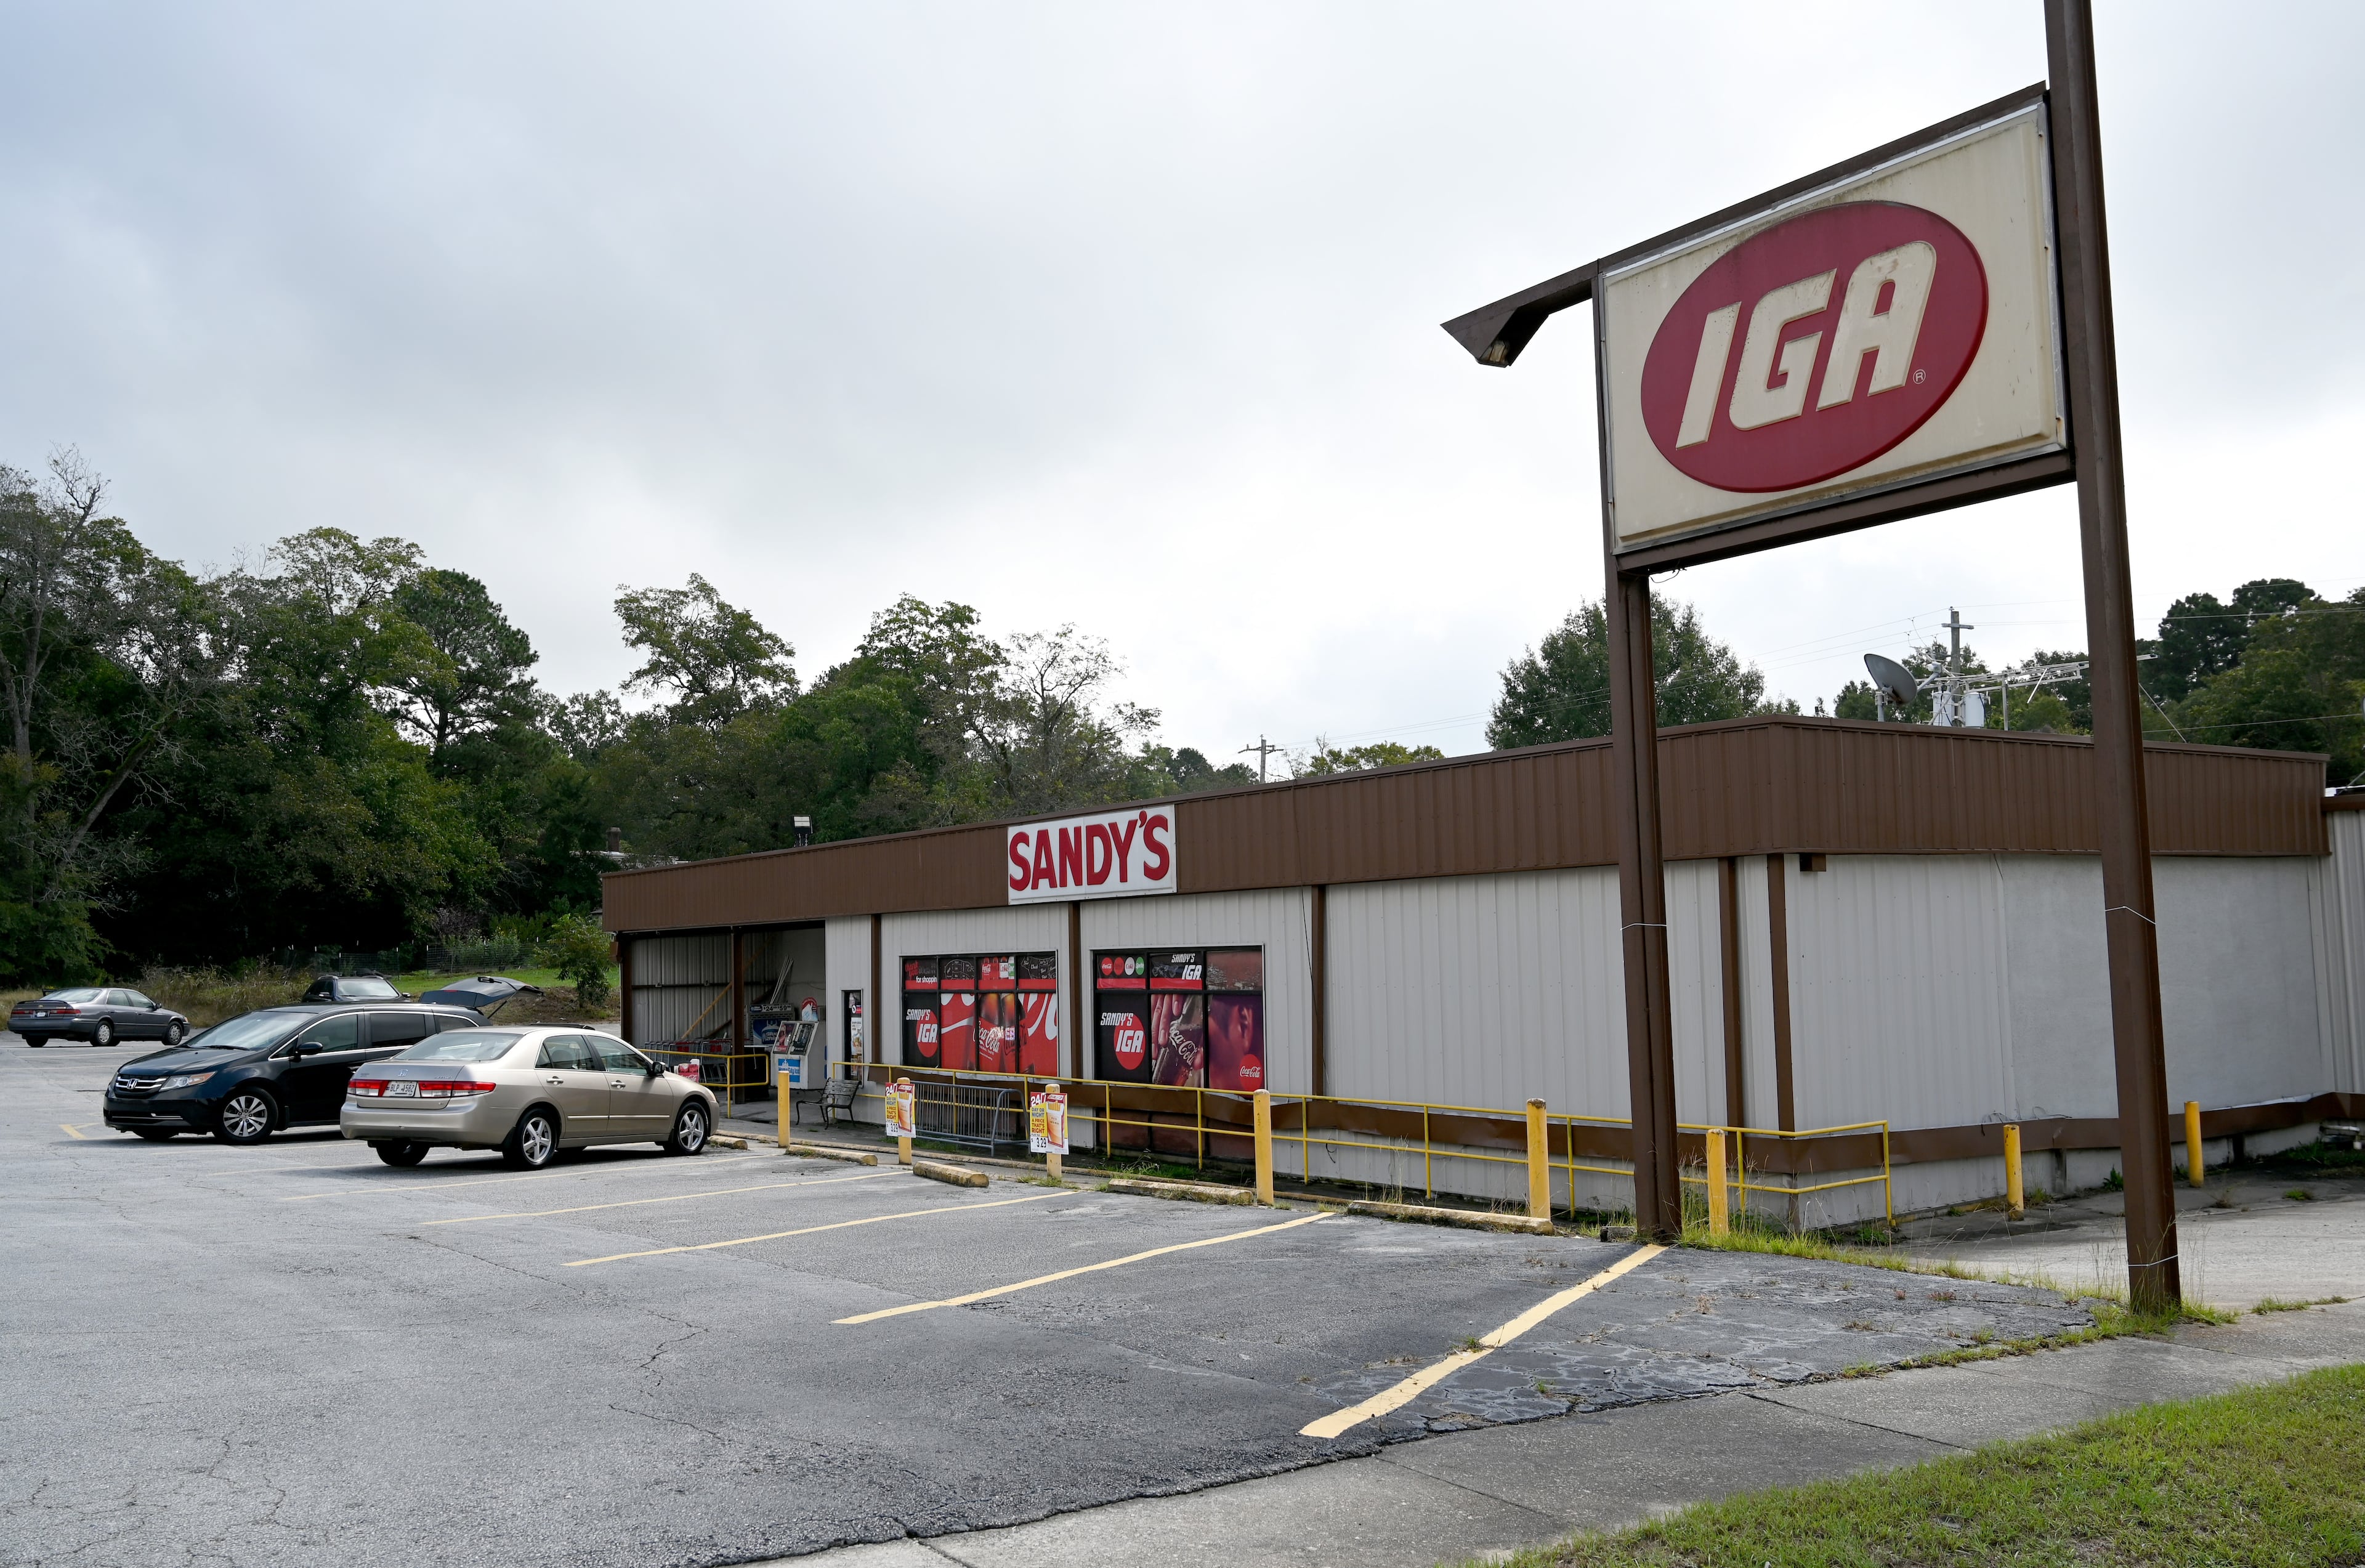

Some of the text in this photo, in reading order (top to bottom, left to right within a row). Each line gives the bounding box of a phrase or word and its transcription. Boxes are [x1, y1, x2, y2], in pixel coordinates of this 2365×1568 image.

[1676, 241, 1937, 450] IGA
[1009, 810, 1170, 892] SANDY'S
[1171, 953, 1195, 963] SANDY'S
[1182, 965, 1202, 980] IGA
[906, 1009, 931, 1020] SANDY'S
[1100, 1012, 1134, 1026] SANDY'S
[918, 1024, 937, 1043] IGA
[1115, 1030, 1144, 1053] IGA
[1240, 1065, 1261, 1078] Coca-Cola
